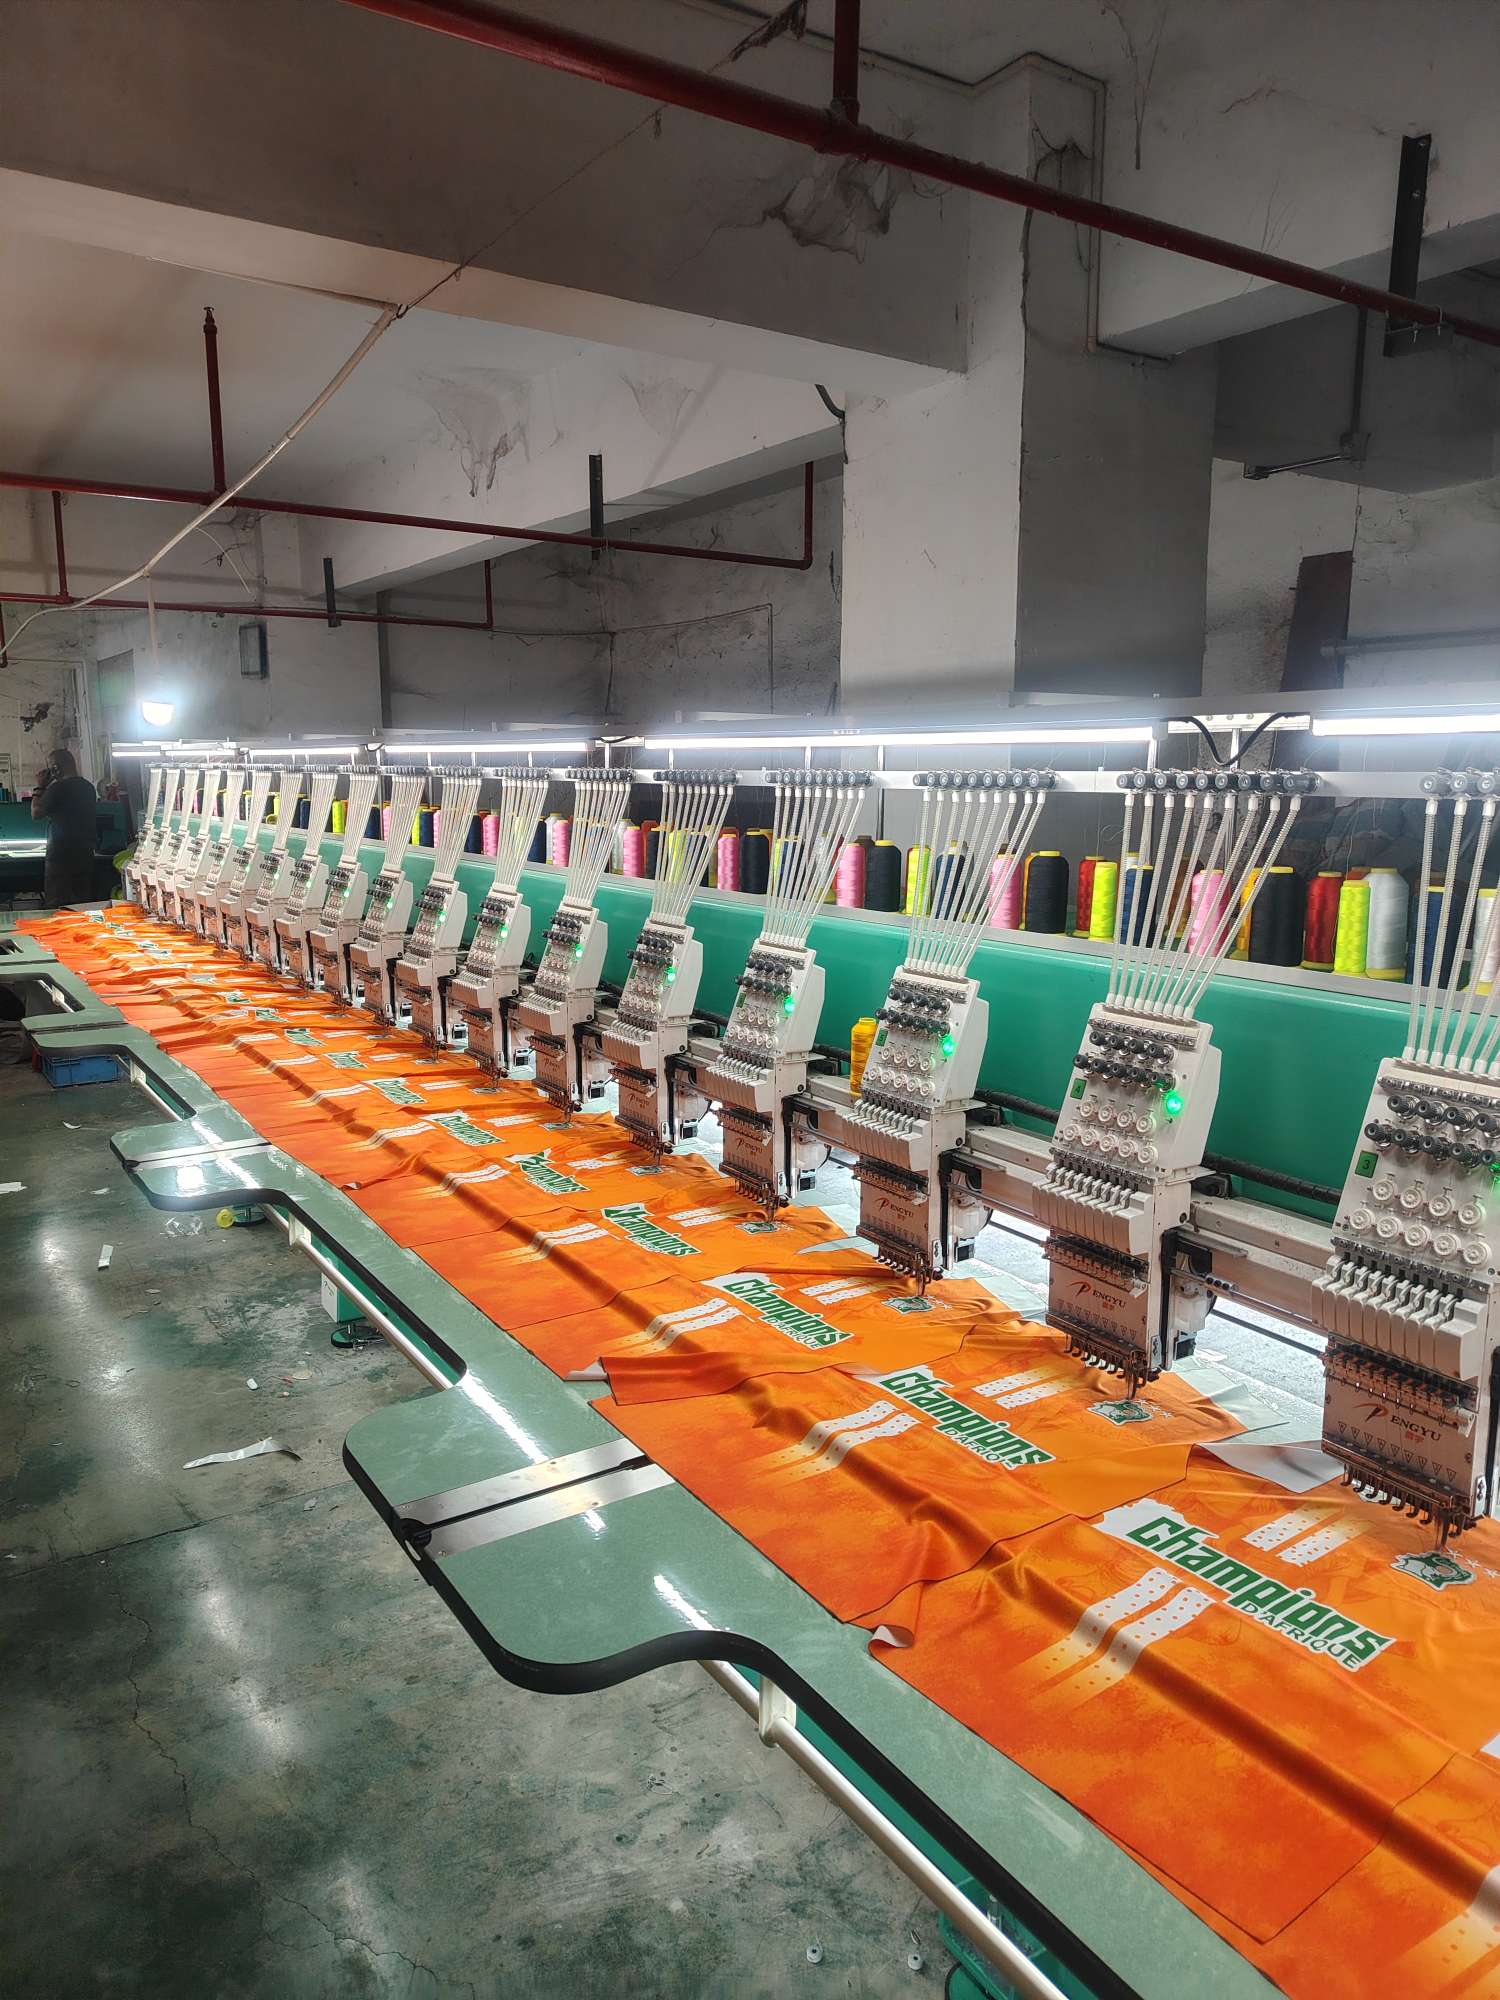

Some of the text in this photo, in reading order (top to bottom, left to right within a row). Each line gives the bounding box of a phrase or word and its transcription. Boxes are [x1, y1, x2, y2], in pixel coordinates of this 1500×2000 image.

[1362, 1159, 1370, 1170] 3
[723, 1279, 853, 1346] Champions
[880, 1372, 1055, 1464] Champions
[1126, 1516, 1392, 1660] Champions
[1240, 1600, 1362, 1668] D'AFRIQUE
